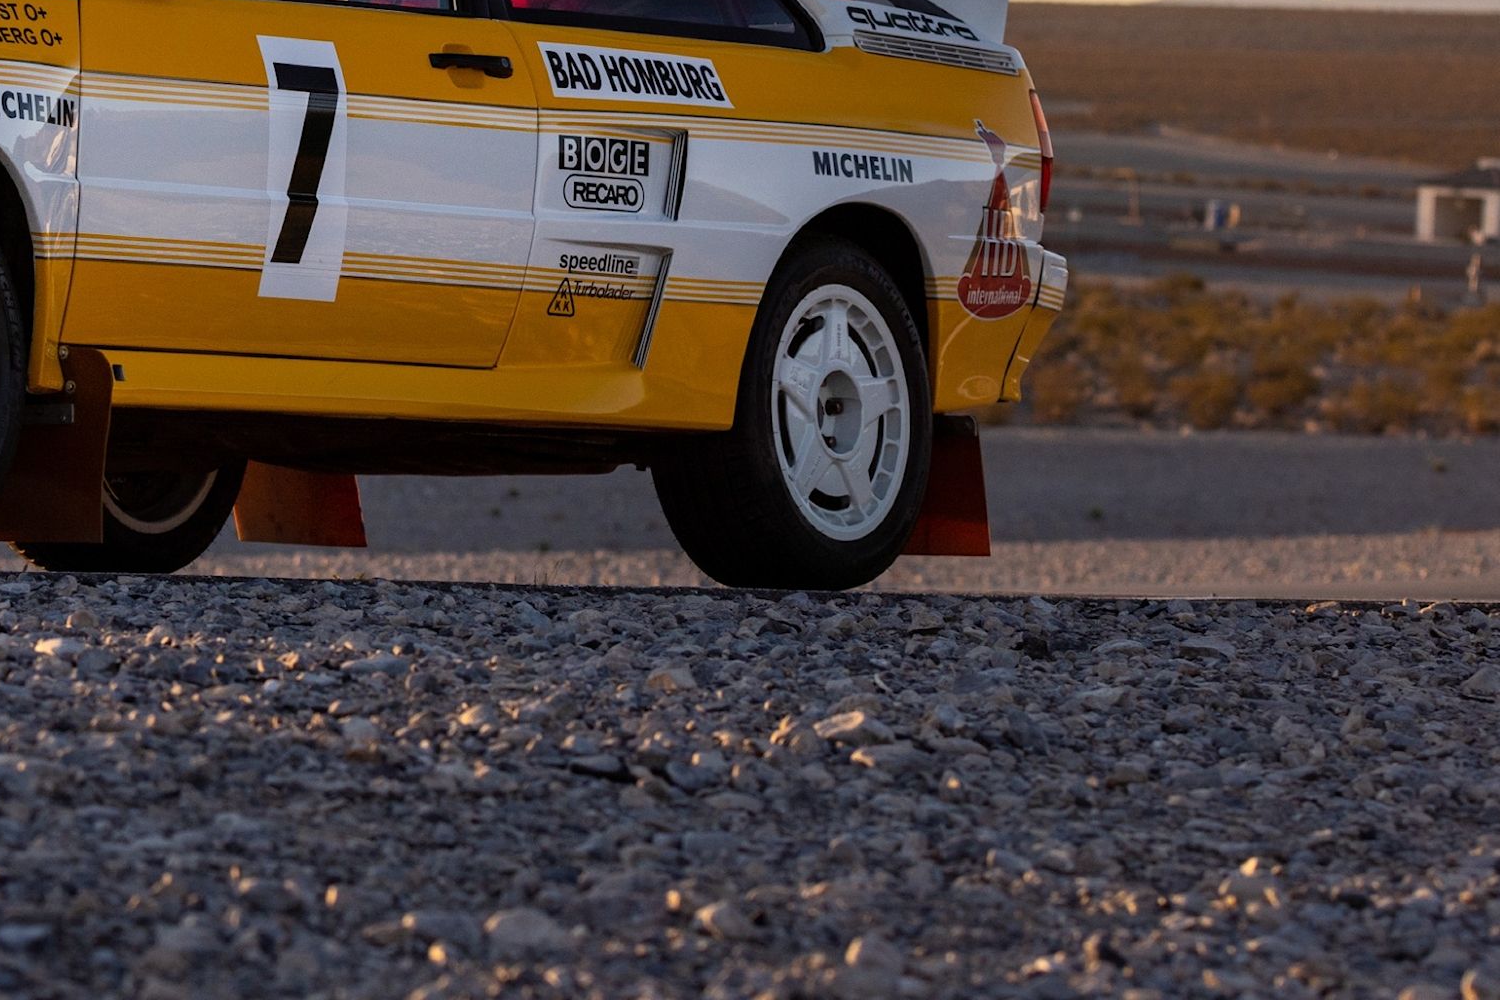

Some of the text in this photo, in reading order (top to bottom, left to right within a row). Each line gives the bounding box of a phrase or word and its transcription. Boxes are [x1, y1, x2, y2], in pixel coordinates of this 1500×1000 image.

[846, 6, 980, 41] quattro
[545, 50, 725, 101] BAD HOMBURG
[270, 62, 339, 264] 7
[559, 135, 649, 176] BOGE
[812, 151, 913, 183] MICHELIN
[573, 181, 639, 206] RECARO
[559, 253, 635, 274] speedline
[573, 280, 636, 300] Turbolader
[966, 283, 1023, 305] international
